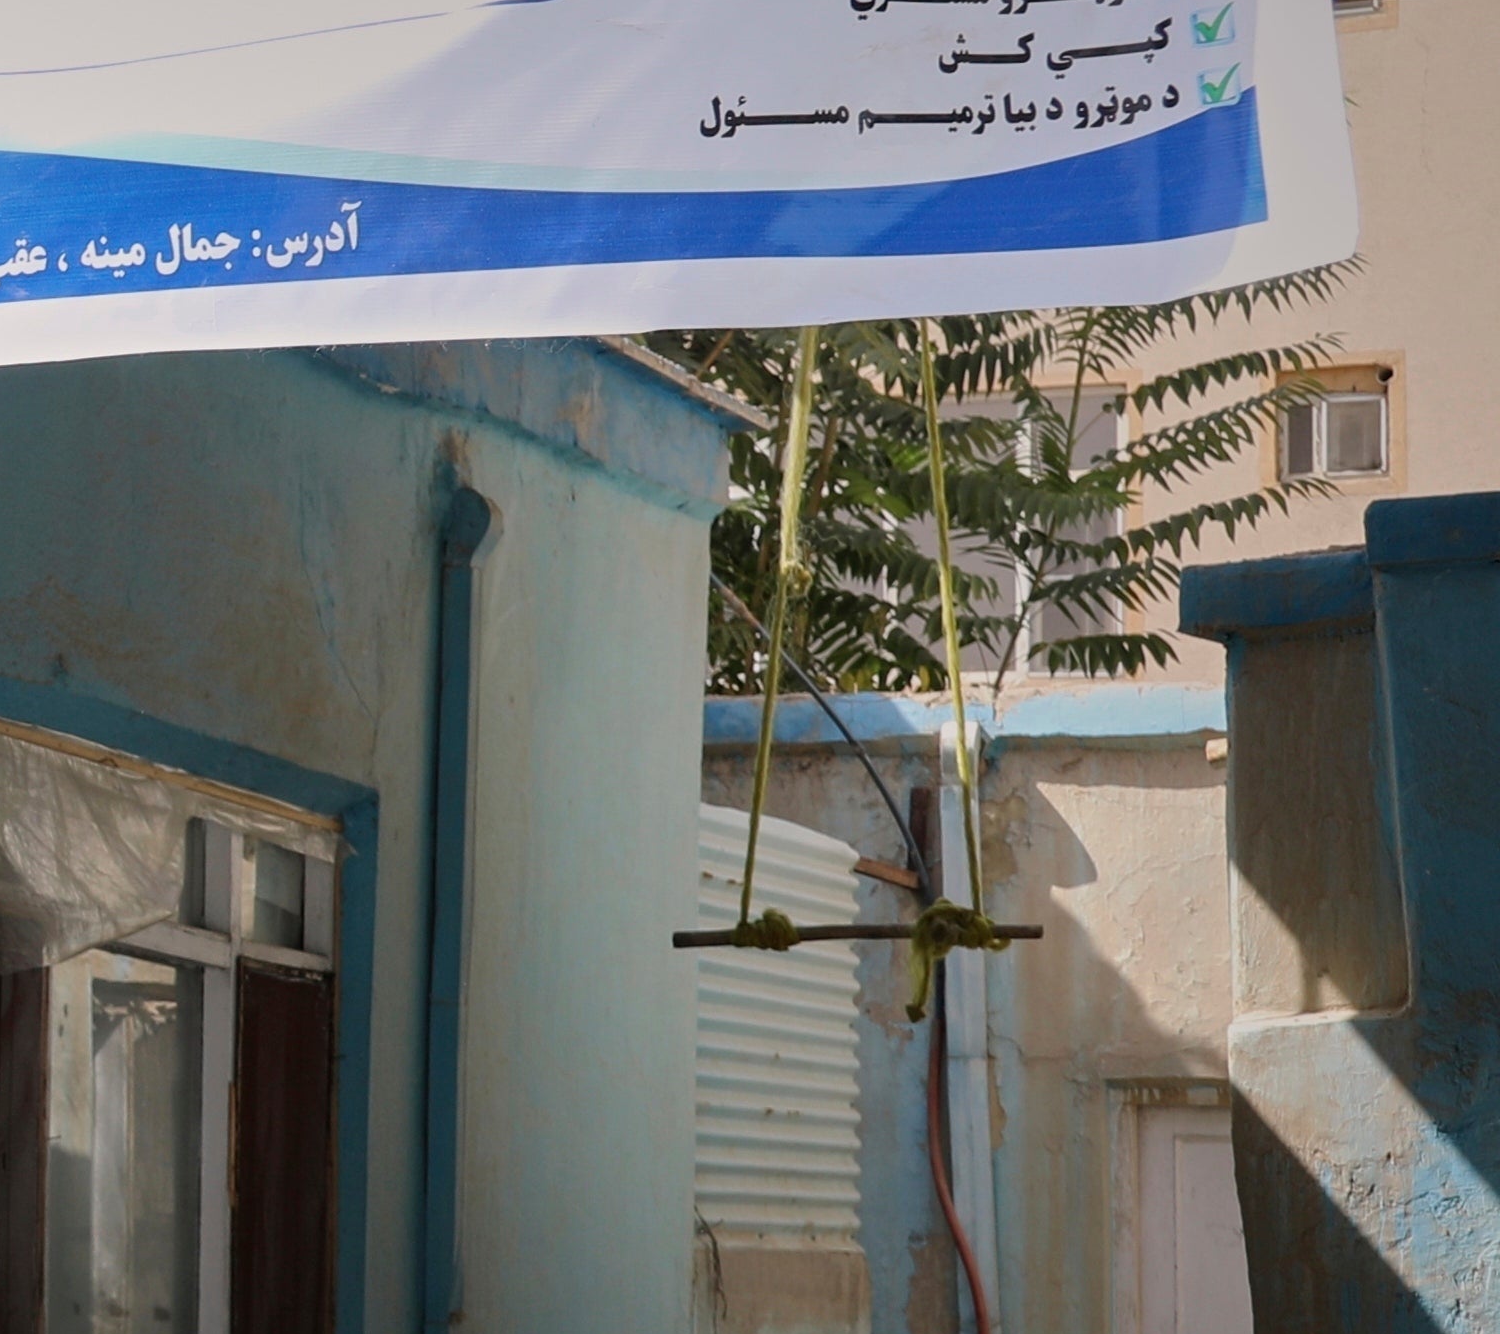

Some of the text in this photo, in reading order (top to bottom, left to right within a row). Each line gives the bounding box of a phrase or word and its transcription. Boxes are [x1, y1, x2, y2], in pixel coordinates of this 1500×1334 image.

[937, 31, 1035, 74] کش
[700, 95, 850, 137] مسئول
[857, 92, 997, 135] ترمیم
[1004, 92, 1038, 133] بیا
[1045, 96, 1064, 120] د
[1161, 83, 1181, 108] د
[155, 223, 242, 275] جمال
[250, 200, 363, 269] آدرس:
[80, 235, 147, 279] مینه
